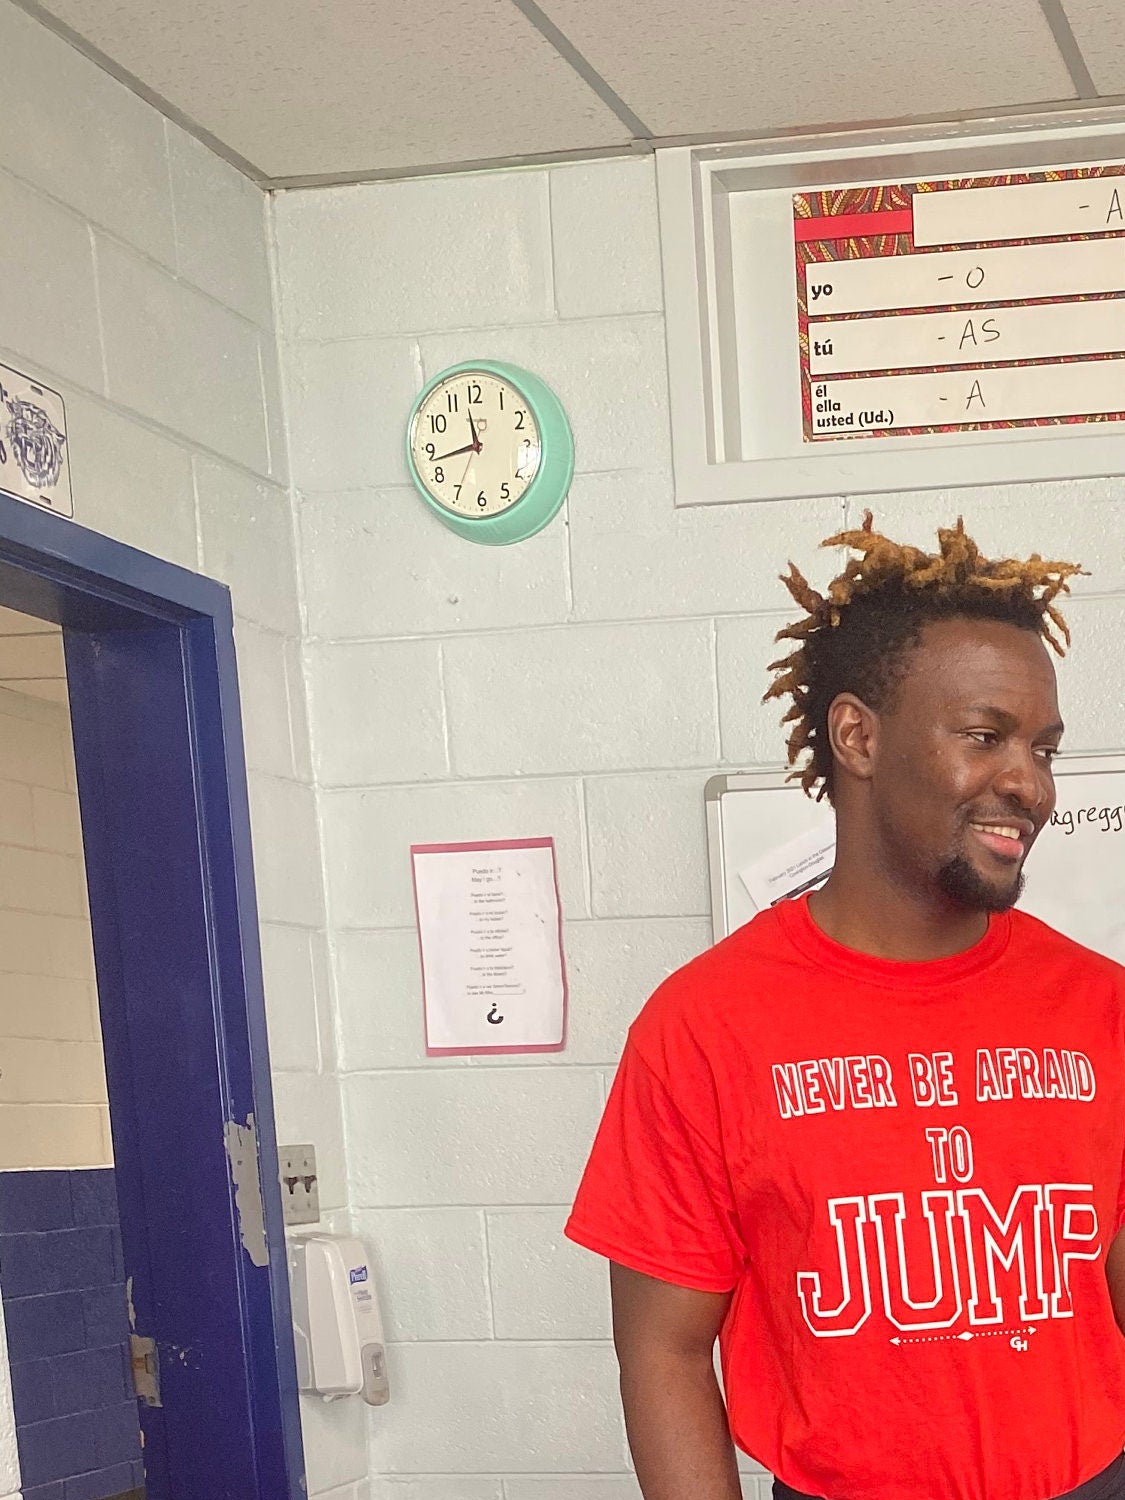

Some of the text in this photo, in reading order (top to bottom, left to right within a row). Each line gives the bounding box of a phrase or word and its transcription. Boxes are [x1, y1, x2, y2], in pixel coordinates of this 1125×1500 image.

[811, 283, 833, 300] yo
[814, 339, 834, 356] tú
[468, 385, 483, 404] 12
[815, 385, 827, 398] él
[816, 400, 841, 412] ella
[431, 415, 447, 433] 10
[515, 411, 525, 430] 2
[817, 410, 895, 427] usted (Ud.)
[426, 443, 435, 461] 9
[435, 467, 445, 483] 8
[454, 485, 463, 501] 7
[478, 491, 487, 507] 6
[500, 483, 510, 499] 5
[772, 1048, 1096, 1119] NEVER BE AFRAID
[926, 1126, 974, 1183] TO
[797, 1184, 1102, 1337] JUMP
